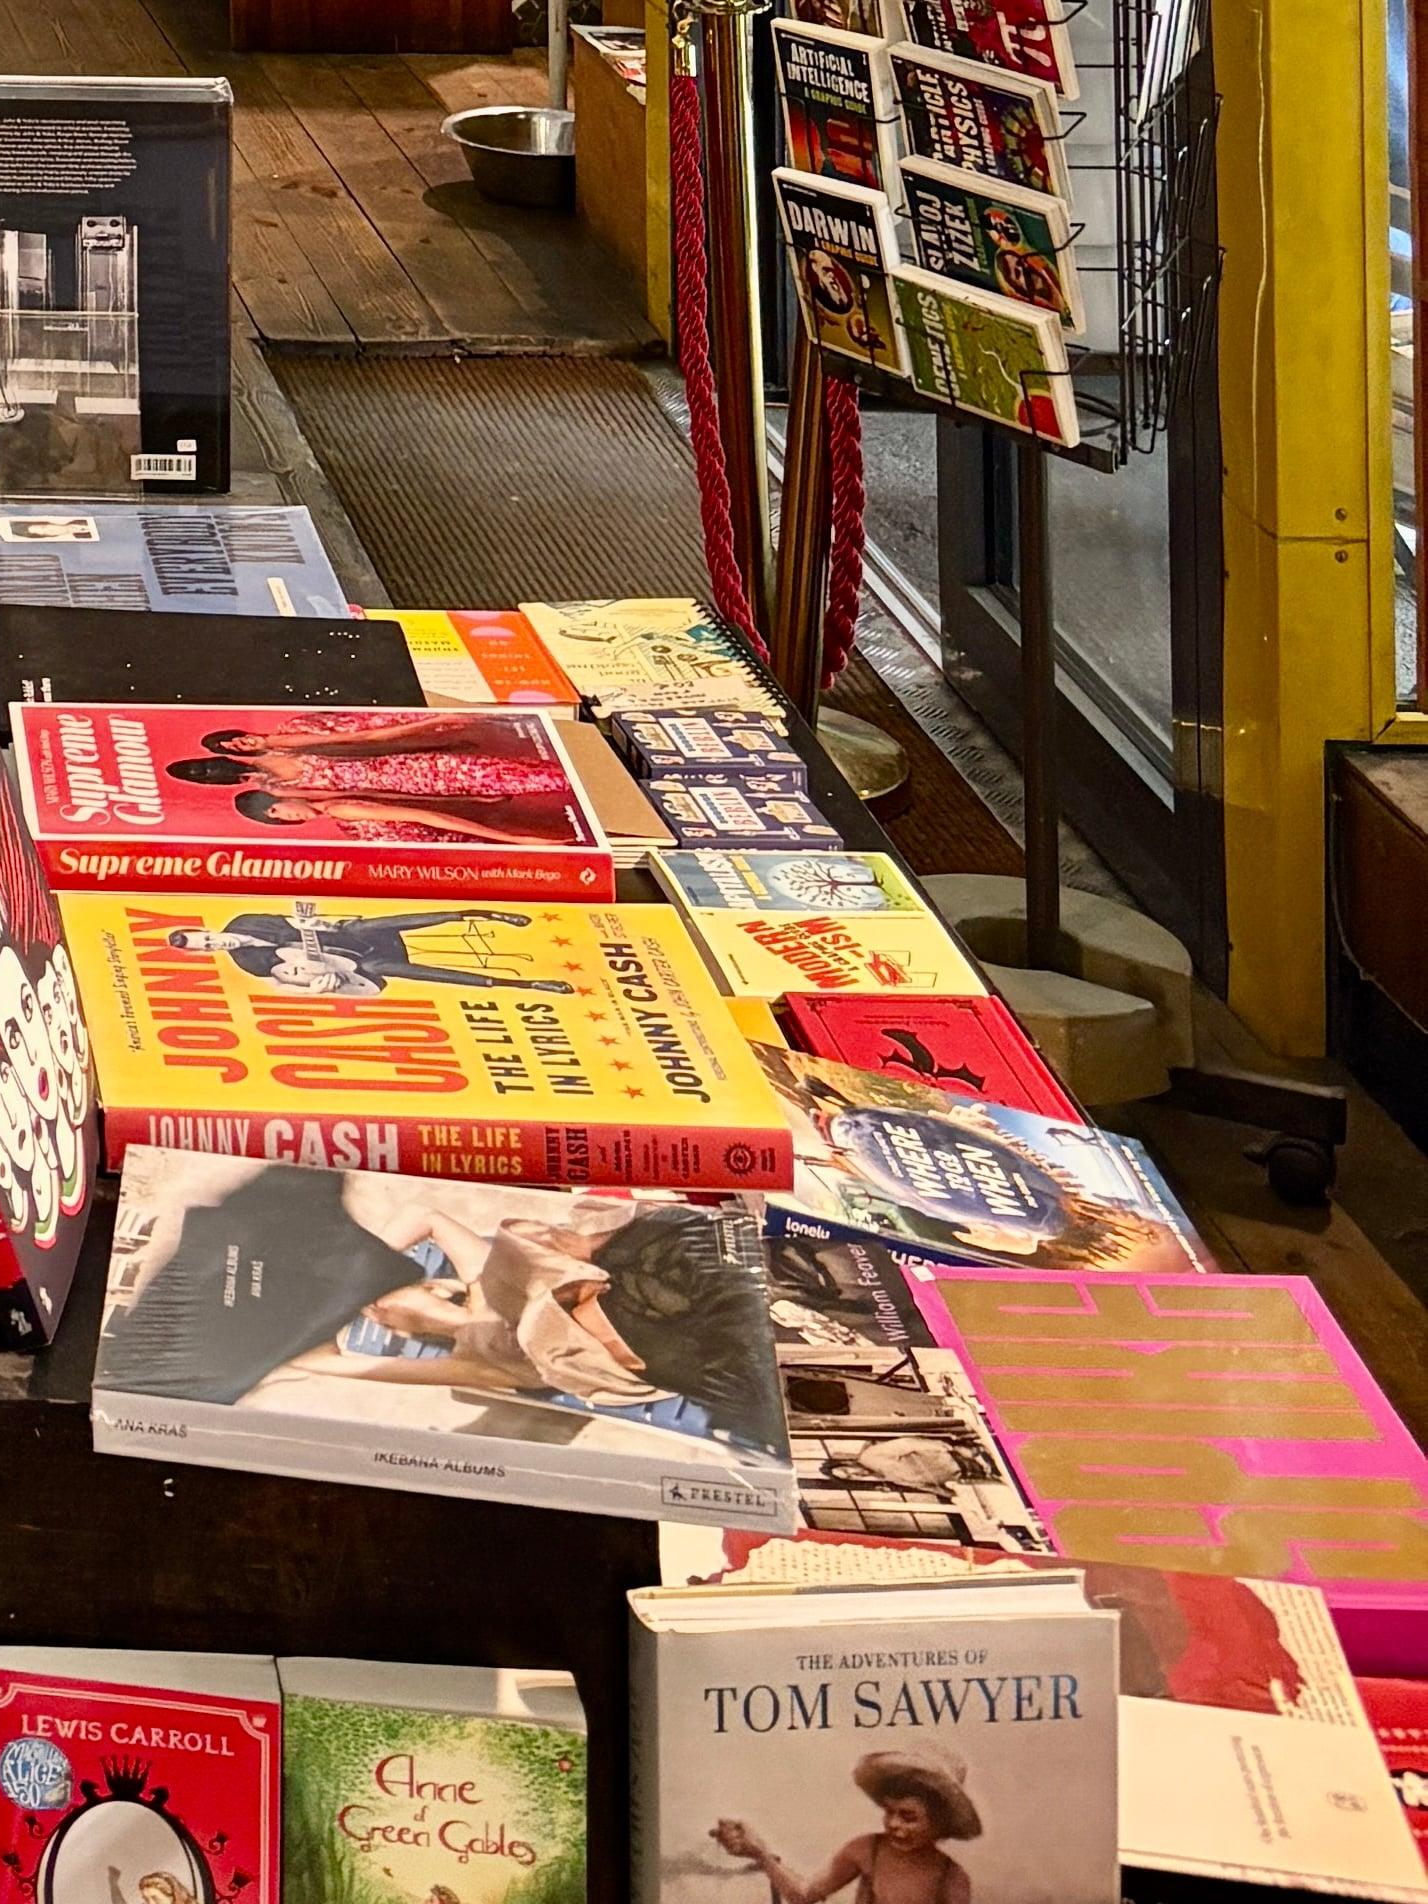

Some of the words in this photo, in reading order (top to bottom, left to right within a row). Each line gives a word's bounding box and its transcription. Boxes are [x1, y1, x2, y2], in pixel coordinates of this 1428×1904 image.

[786, 61, 870, 103] INTELLIGENCE
[791, 44, 854, 78] ARTIFICIAL
[945, 81, 978, 174] PHYSICS
[788, 200, 875, 254] DARWIN
[58, 714, 112, 827] Supreme
[107, 714, 166, 827] Glamour
[59, 848, 203, 880] Supreme
[206, 852, 351, 881] Glamour
[368, 864, 414, 879] MARY
[416, 864, 479, 881] WILSON
[600, 942, 659, 1003] CASH
[736, 919, 860, 989] MODERN
[124, 906, 250, 1085] JOHNNY
[459, 998, 507, 1045] LIFE
[250, 993, 469, 1094] CASH
[516, 1001, 582, 1068] LYRICS
[632, 1007, 711, 1104] JOHNNY
[483, 1052, 535, 1096] THE
[549, 1071, 595, 1095] IN
[148, 1114, 250, 1162] JOHNNY
[263, 1117, 400, 1171] CASH
[417, 1124, 465, 1148] THE
[471, 1127, 522, 1150] LIFE
[421, 1153, 443, 1174] IN
[448, 1153, 522, 1176] LYRICS
[882, 1121, 952, 1199] WHERE
[954, 1143, 1027, 1217] WHEN
[689, 1488, 766, 1509] PRESTEL
[796, 1653, 833, 1671] THE
[838, 1650, 958, 1671] ADVENTURES
[963, 1648, 989, 1667] OF
[704, 1681, 833, 1735] TOM
[852, 1673, 1083, 1729] SAWYER
[21, 1714, 102, 1743] LEWIS
[110, 1721, 235, 1758] CARROLL
[375, 1753, 482, 1805] Anne
[338, 1803, 431, 1854] Green
[437, 1821, 538, 1866] Gables
